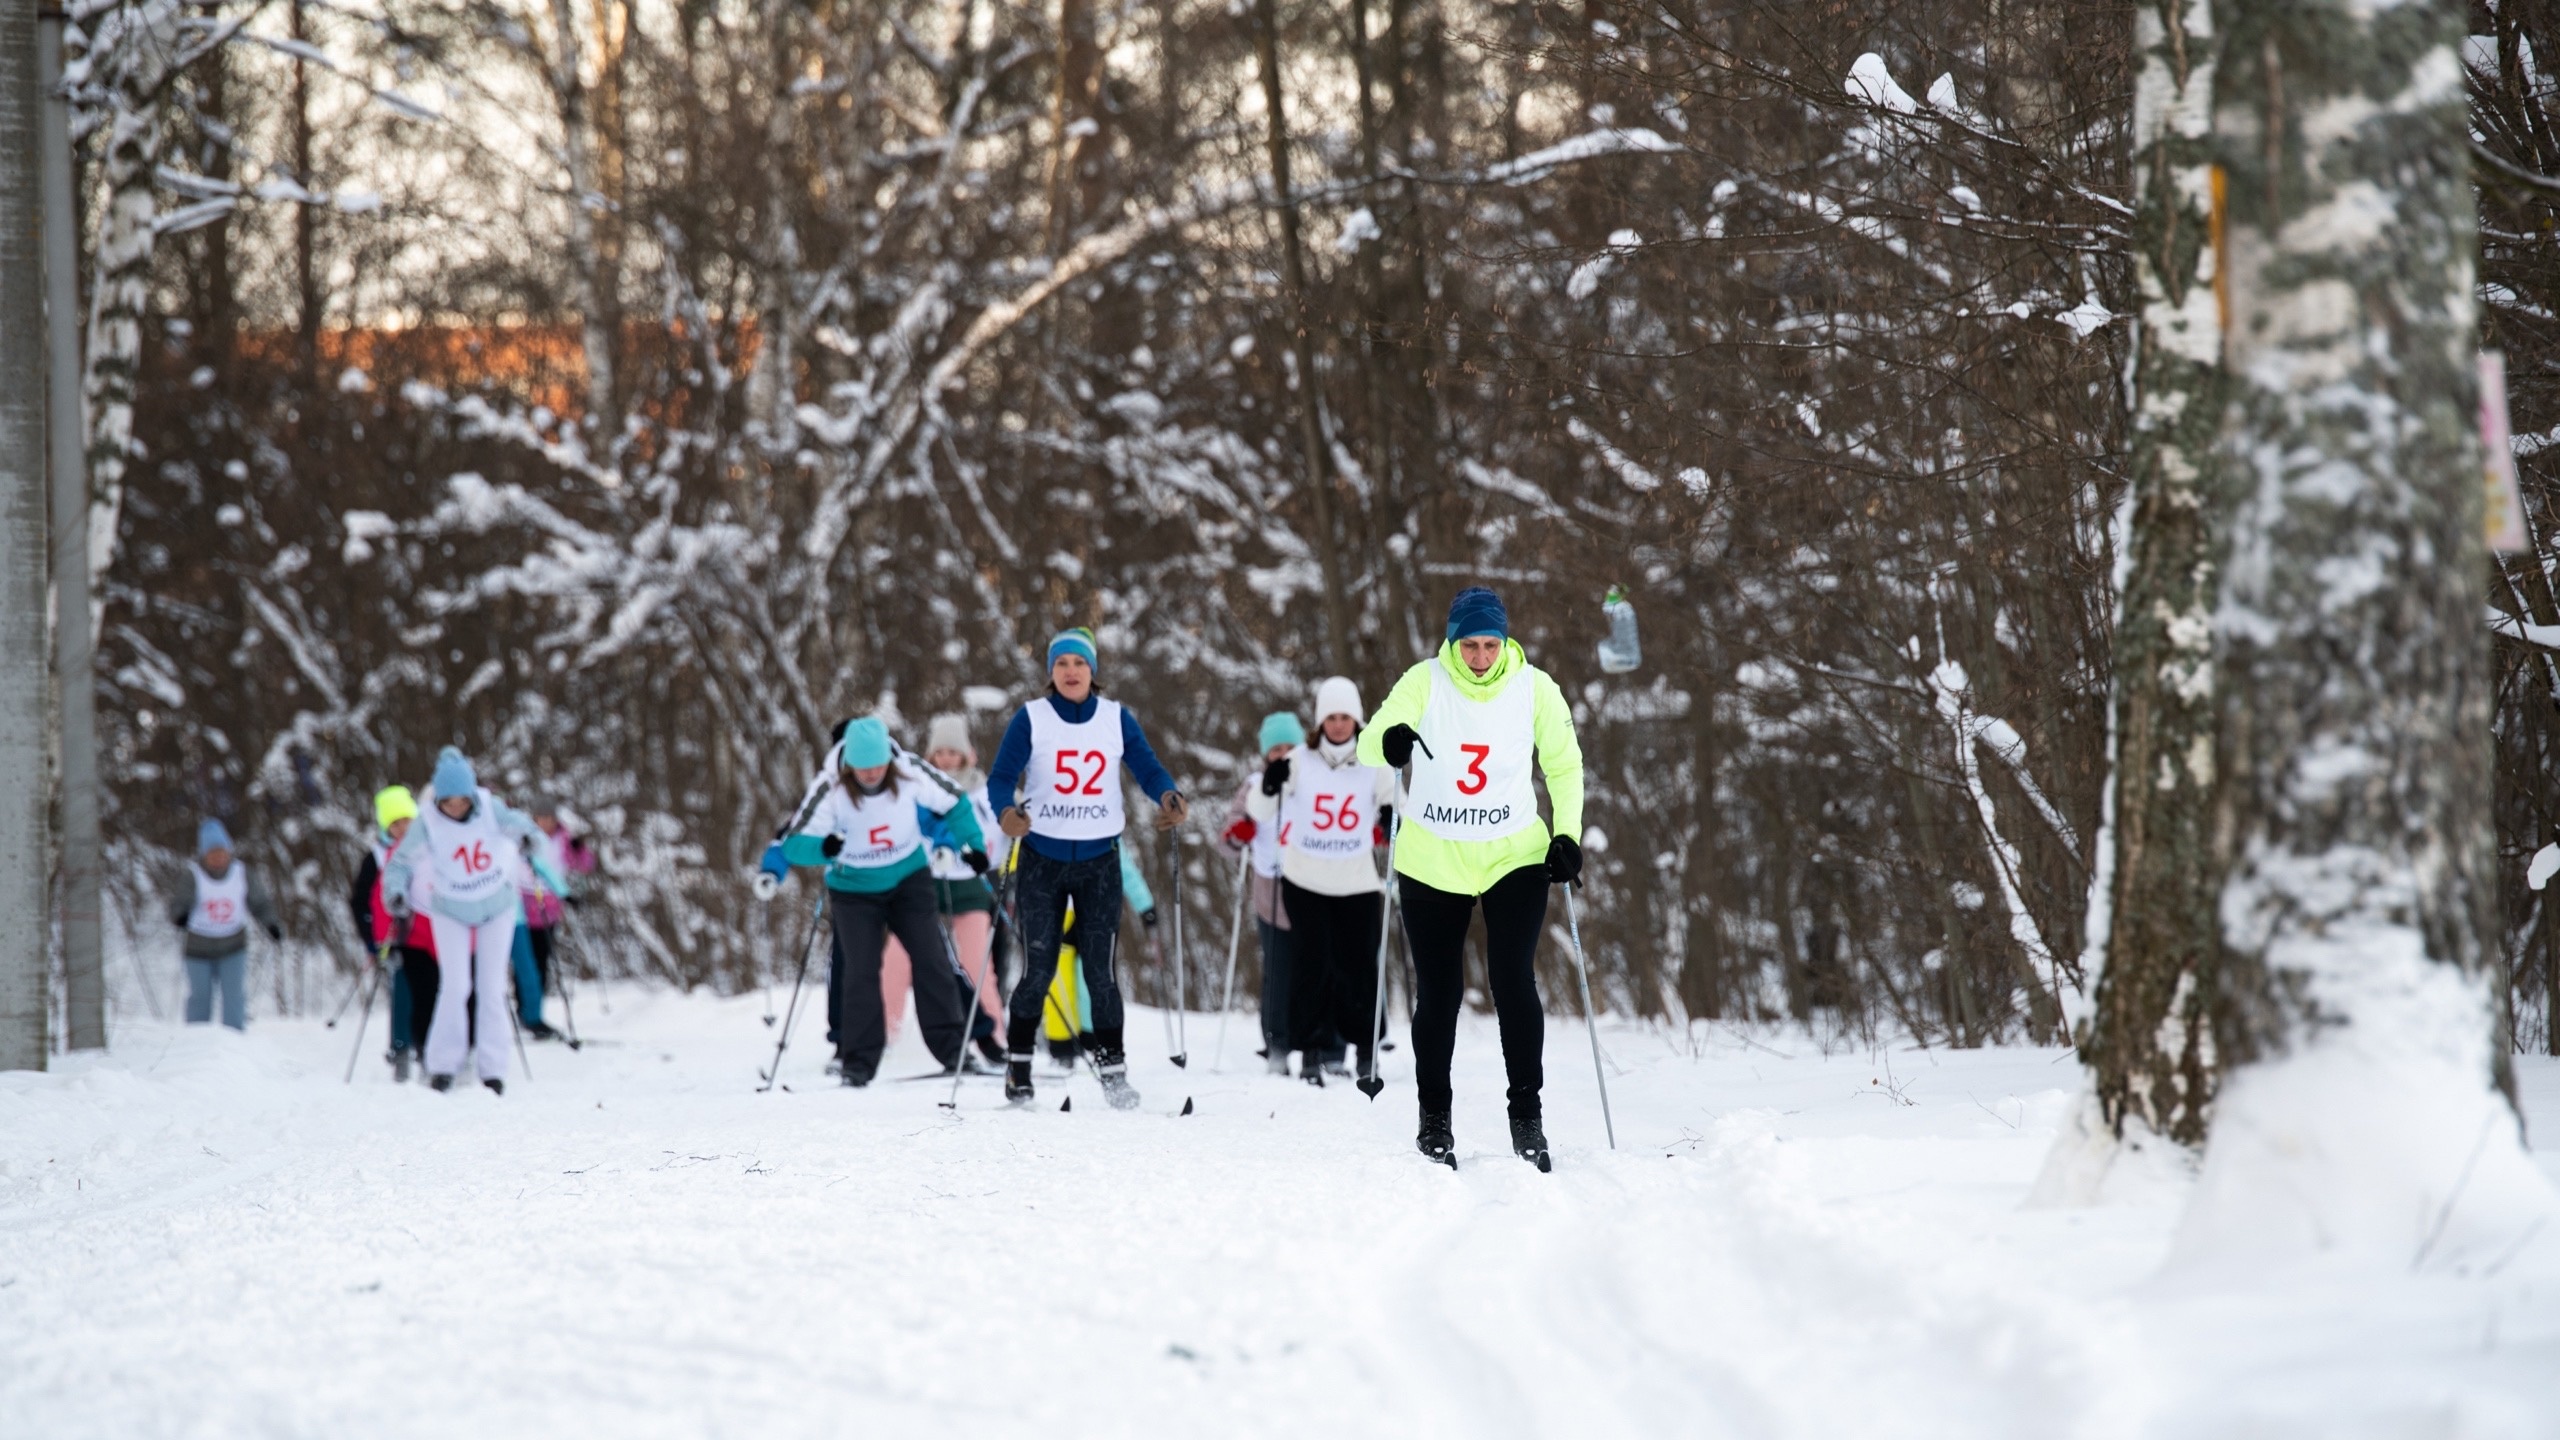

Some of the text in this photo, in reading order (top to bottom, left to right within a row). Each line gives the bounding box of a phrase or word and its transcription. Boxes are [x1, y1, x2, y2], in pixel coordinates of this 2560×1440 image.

[1054, 749, 1107, 795] 52
[1456, 744, 1490, 795] 3
[1039, 804, 1109, 819] ДМИТРОВ
[1312, 793, 1360, 831] 56
[1423, 803, 1510, 825] ДМИТРОВ
[867, 825, 894, 852] 5
[453, 840, 492, 876] 16
